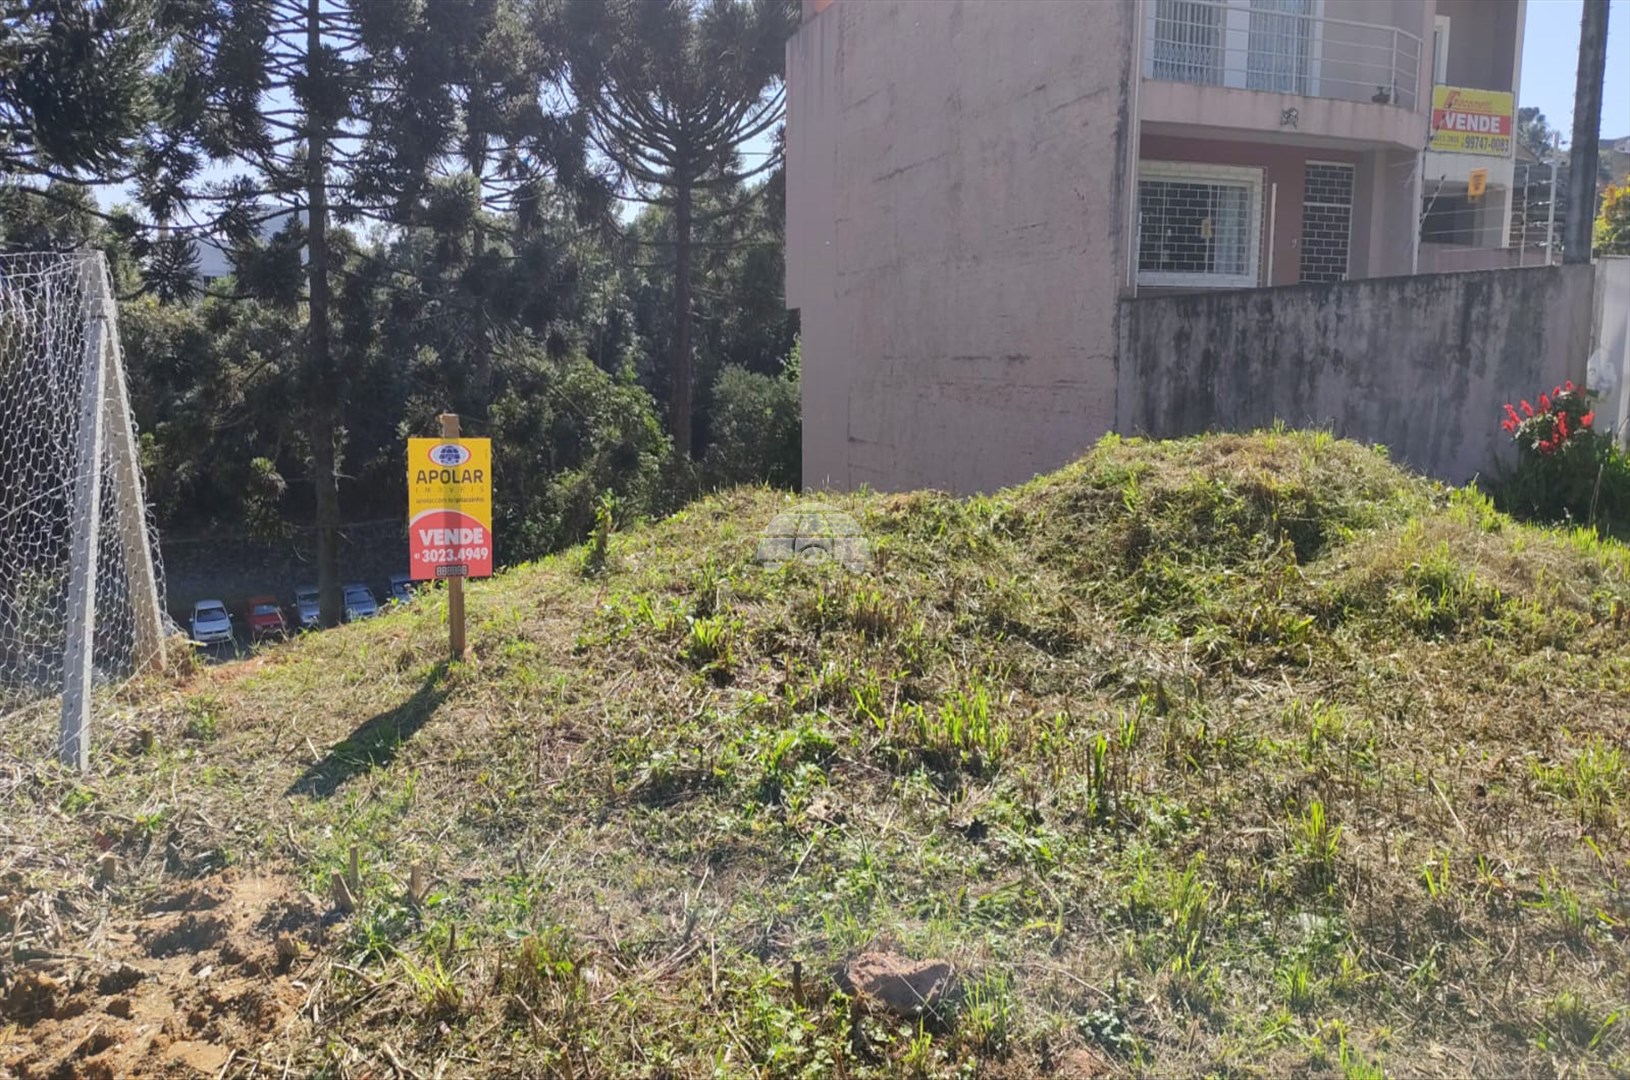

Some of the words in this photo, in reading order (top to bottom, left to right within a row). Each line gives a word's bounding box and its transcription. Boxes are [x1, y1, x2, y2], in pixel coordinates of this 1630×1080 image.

[1444, 112, 1500, 133] VENDE
[416, 469, 483, 485] APOLAR
[418, 527, 484, 547] VENDE
[422, 547, 489, 563] 3023.4949
